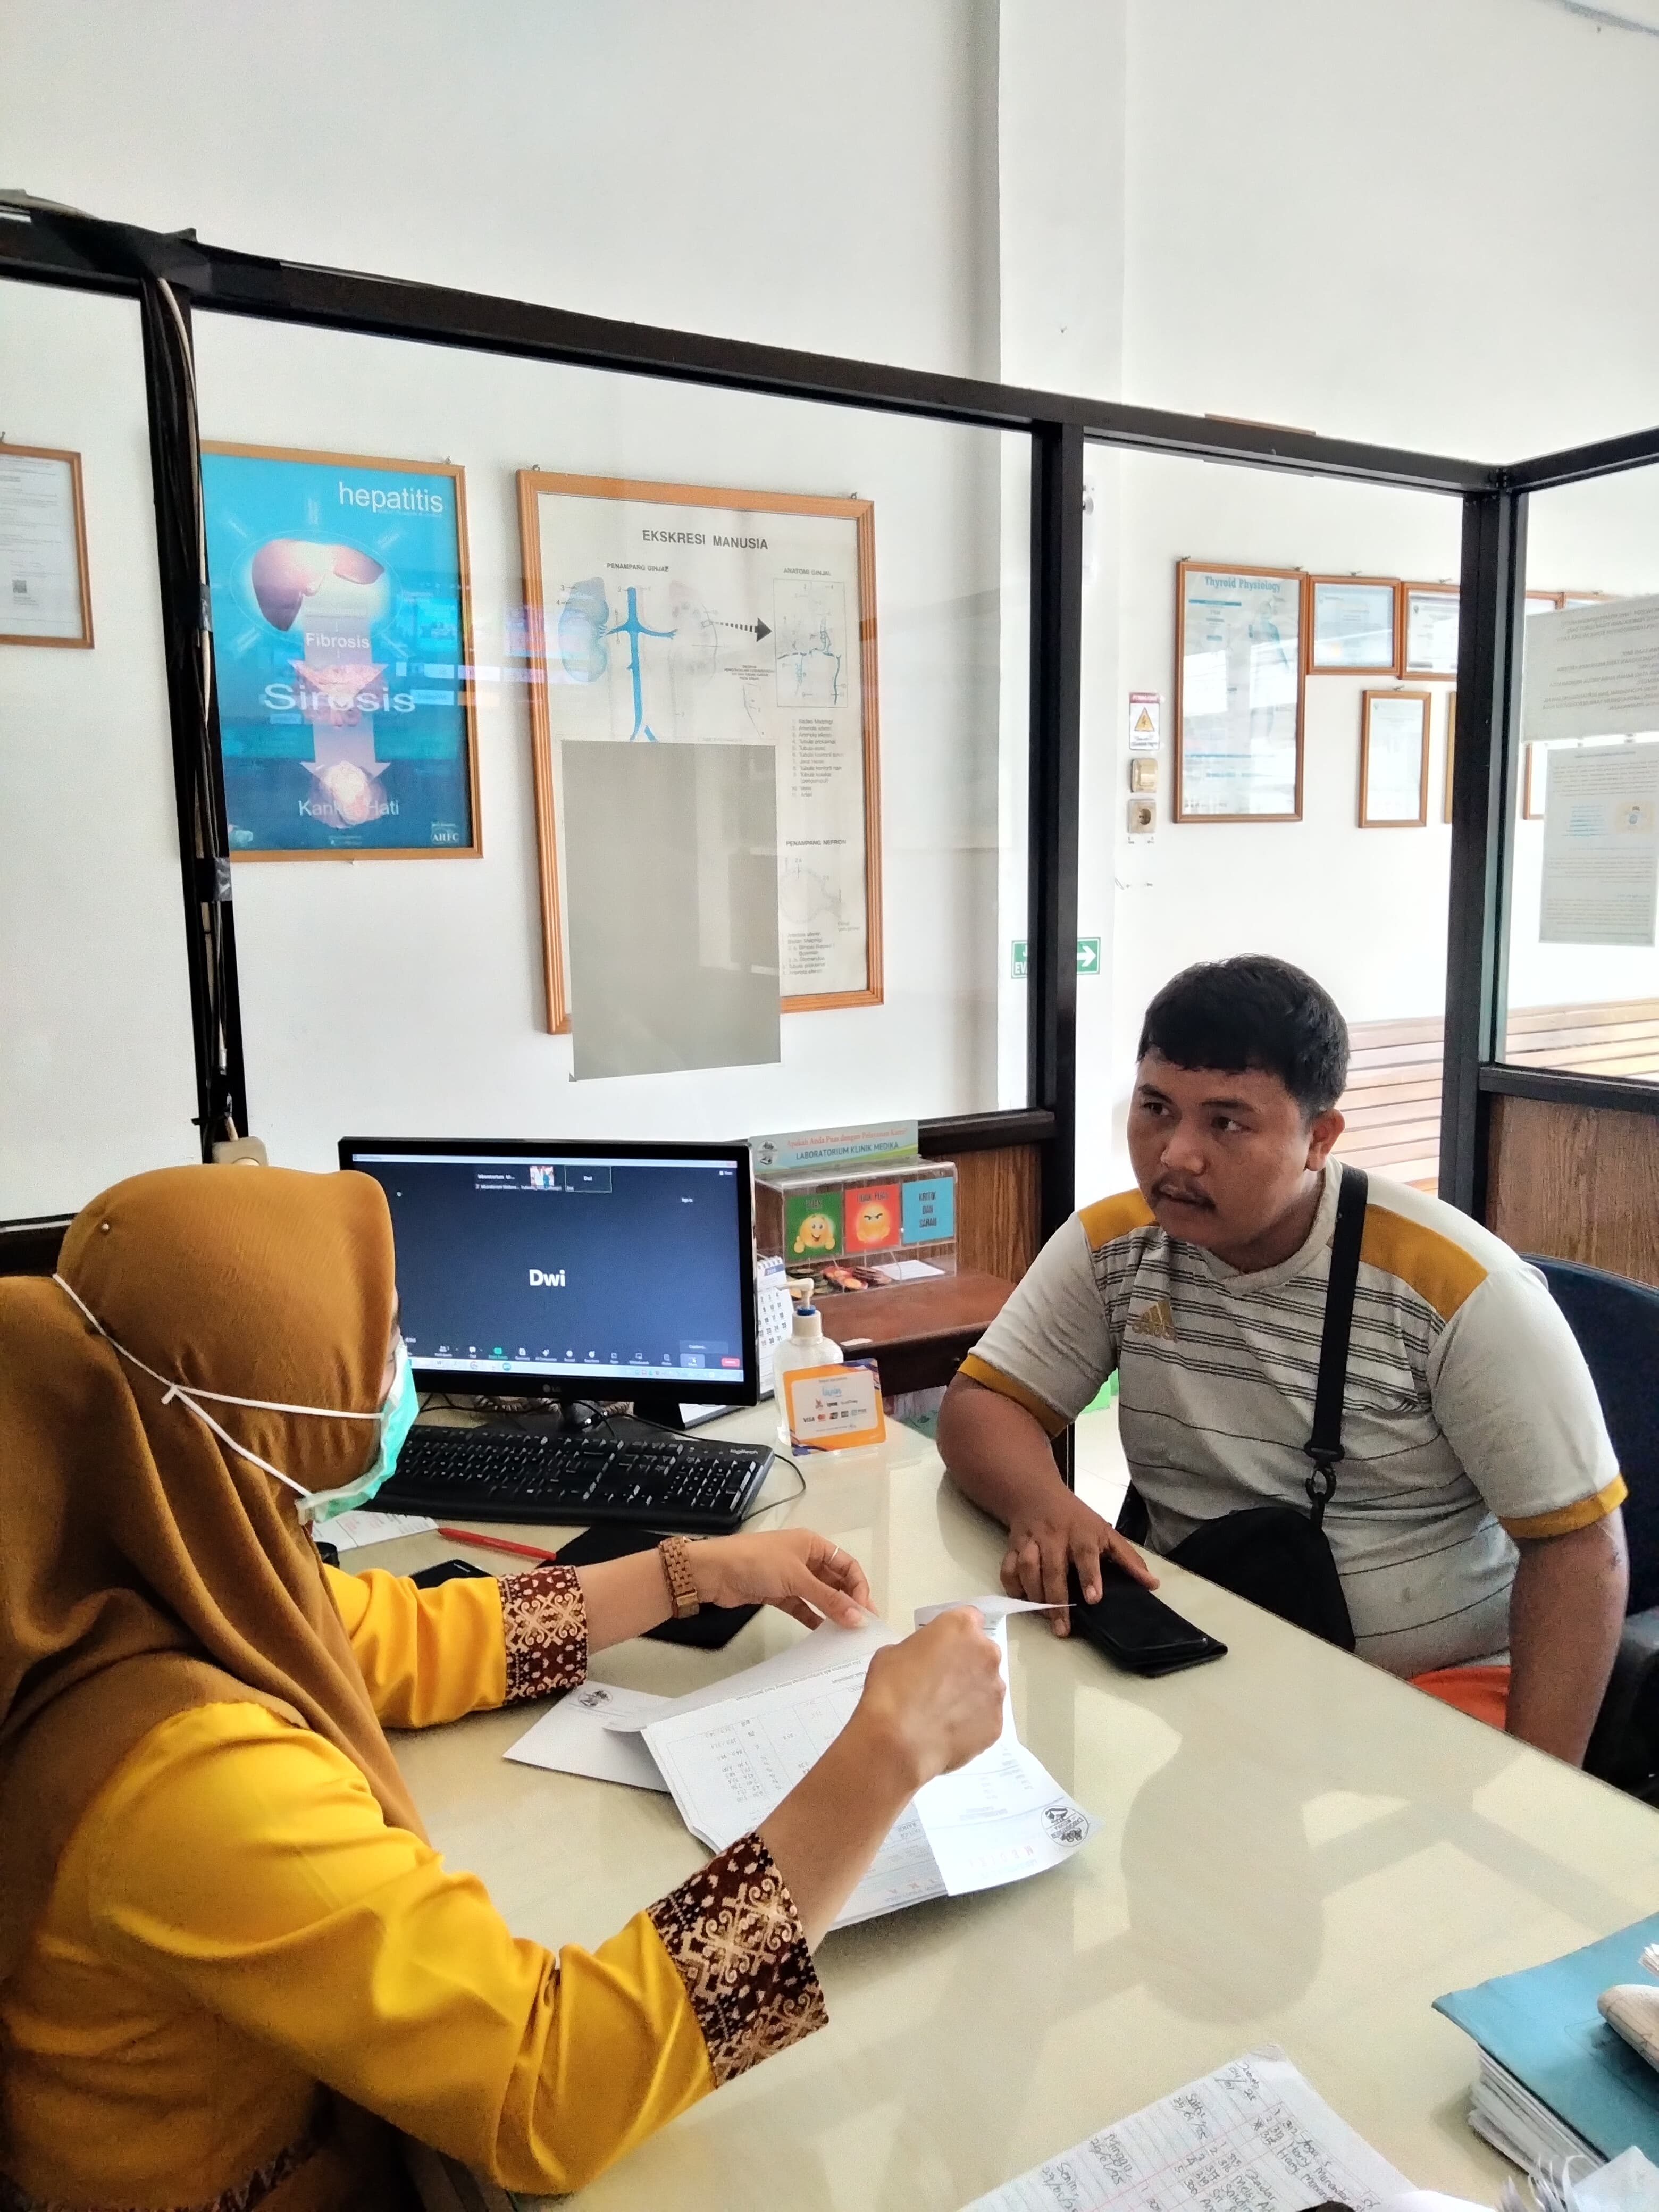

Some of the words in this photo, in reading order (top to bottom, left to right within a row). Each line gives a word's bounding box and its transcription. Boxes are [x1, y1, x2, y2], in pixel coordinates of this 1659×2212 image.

[339, 481, 443, 513] hepatitis
[642, 530, 706, 546] EKSKRESI
[713, 535, 769, 550] MANUSIA
[606, 562, 646, 572] PENAMPANG
[1205, 576, 1236, 589] Thyroid
[1238, 579, 1281, 593] Physiology
[305, 632, 370, 649] Fibrosis
[264, 683, 416, 713] Sirosis
[826, 1135, 840, 1144] Puas
[795, 1147, 849, 1160] LABORATORIUM
[850, 1143, 873, 1153] KLINIK
[873, 1141, 899, 1151] MEDIKA
[919, 1191, 936, 1202] KRITIK
[922, 1204, 934, 1215] DAN
[529, 1269, 566, 1287] Dwi
